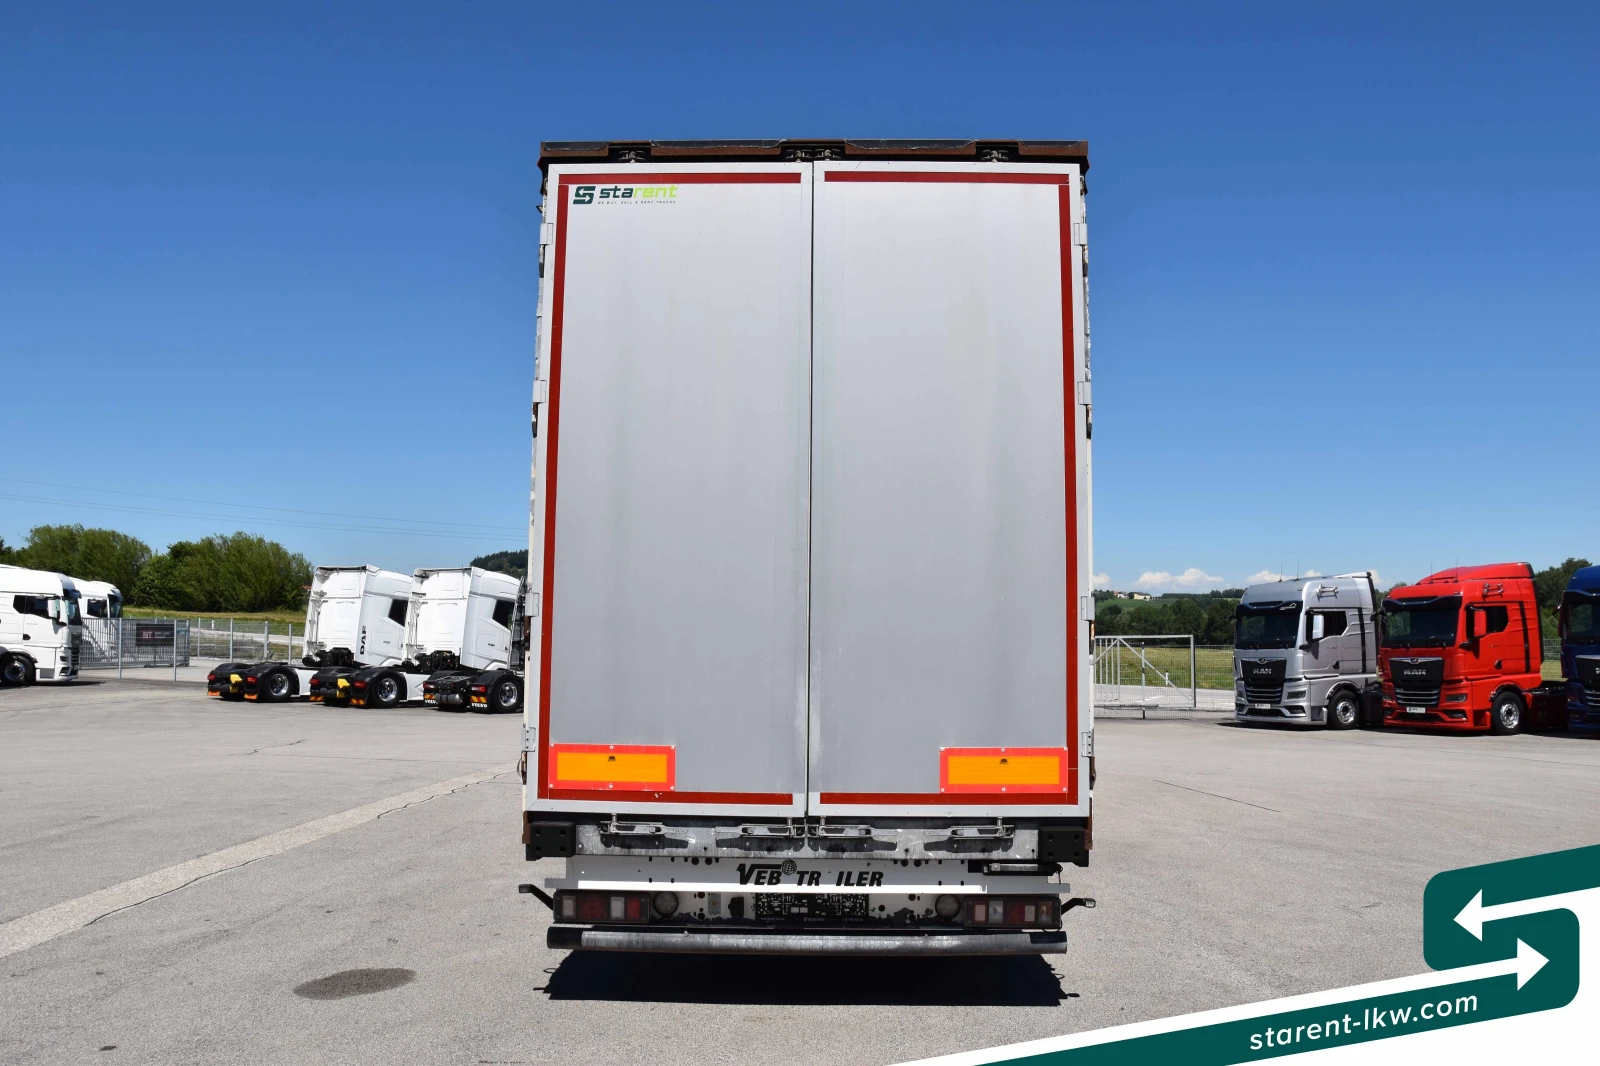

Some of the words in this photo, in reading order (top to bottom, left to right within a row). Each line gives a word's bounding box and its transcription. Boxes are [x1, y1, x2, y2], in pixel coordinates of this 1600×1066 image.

[599, 184, 678, 199] starent
[359, 624, 367, 655] DAF
[736, 863, 782, 886] VEB
[796, 870, 884, 887] TRILER
